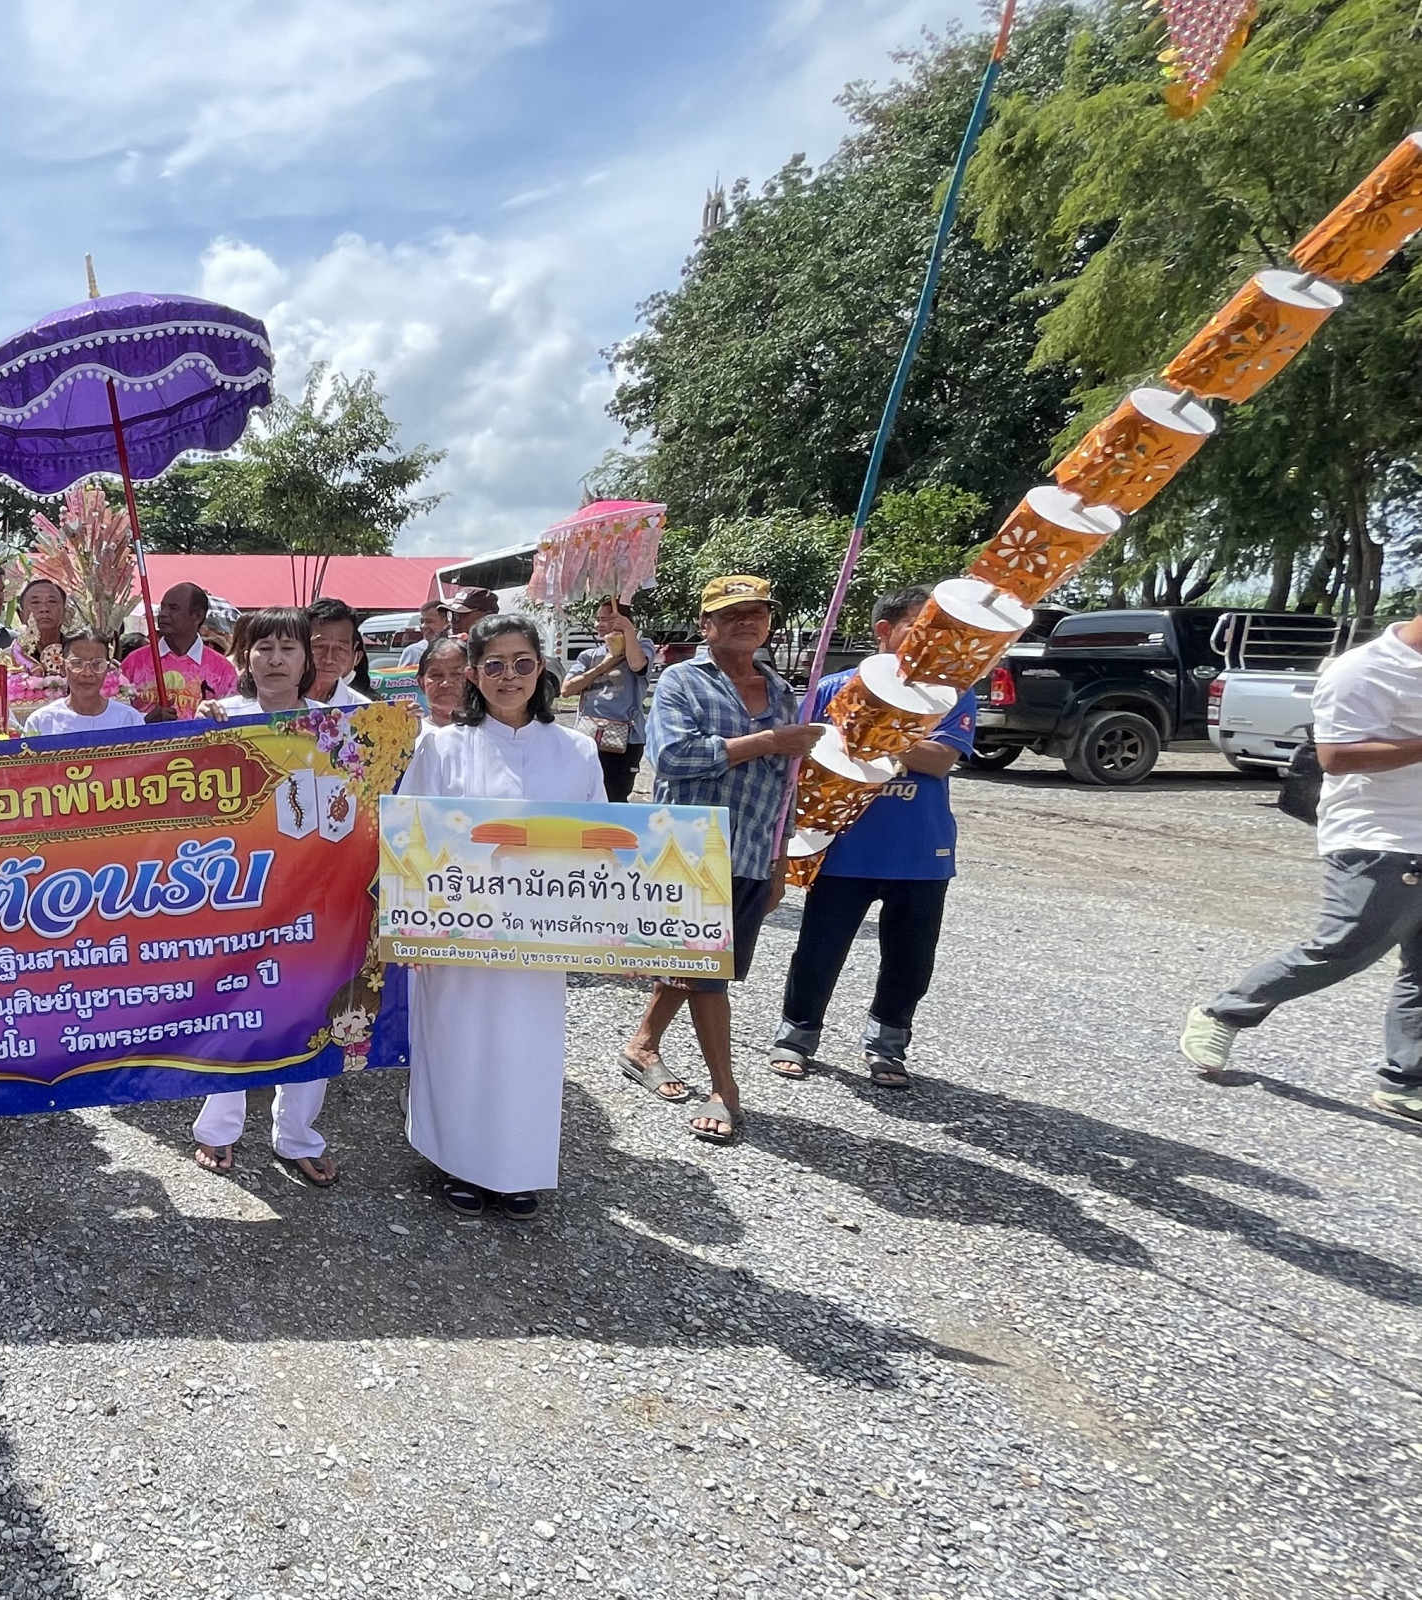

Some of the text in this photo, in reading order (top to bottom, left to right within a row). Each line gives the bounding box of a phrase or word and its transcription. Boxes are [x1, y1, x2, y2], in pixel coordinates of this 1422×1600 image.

[427, 864, 684, 903] กฐินสามัคคีทั่วไทย
[140, 914, 313, 961] มหาทานบารมี
[391, 909, 722, 940] ๓๐,๐๐๐ วัด พุทธศักราช ๒๕๖๘
[216, 974, 249, 993] ๘๑
[256, 958, 279, 986] ปี
[393, 943, 720, 972] โดย คณะศิษยานุศิษย์ บูชาธรรม ๘๑ ปี หลวงพ่อธัมมชโย
[60, 1008, 262, 1053] วัดพระธรรมกาย
